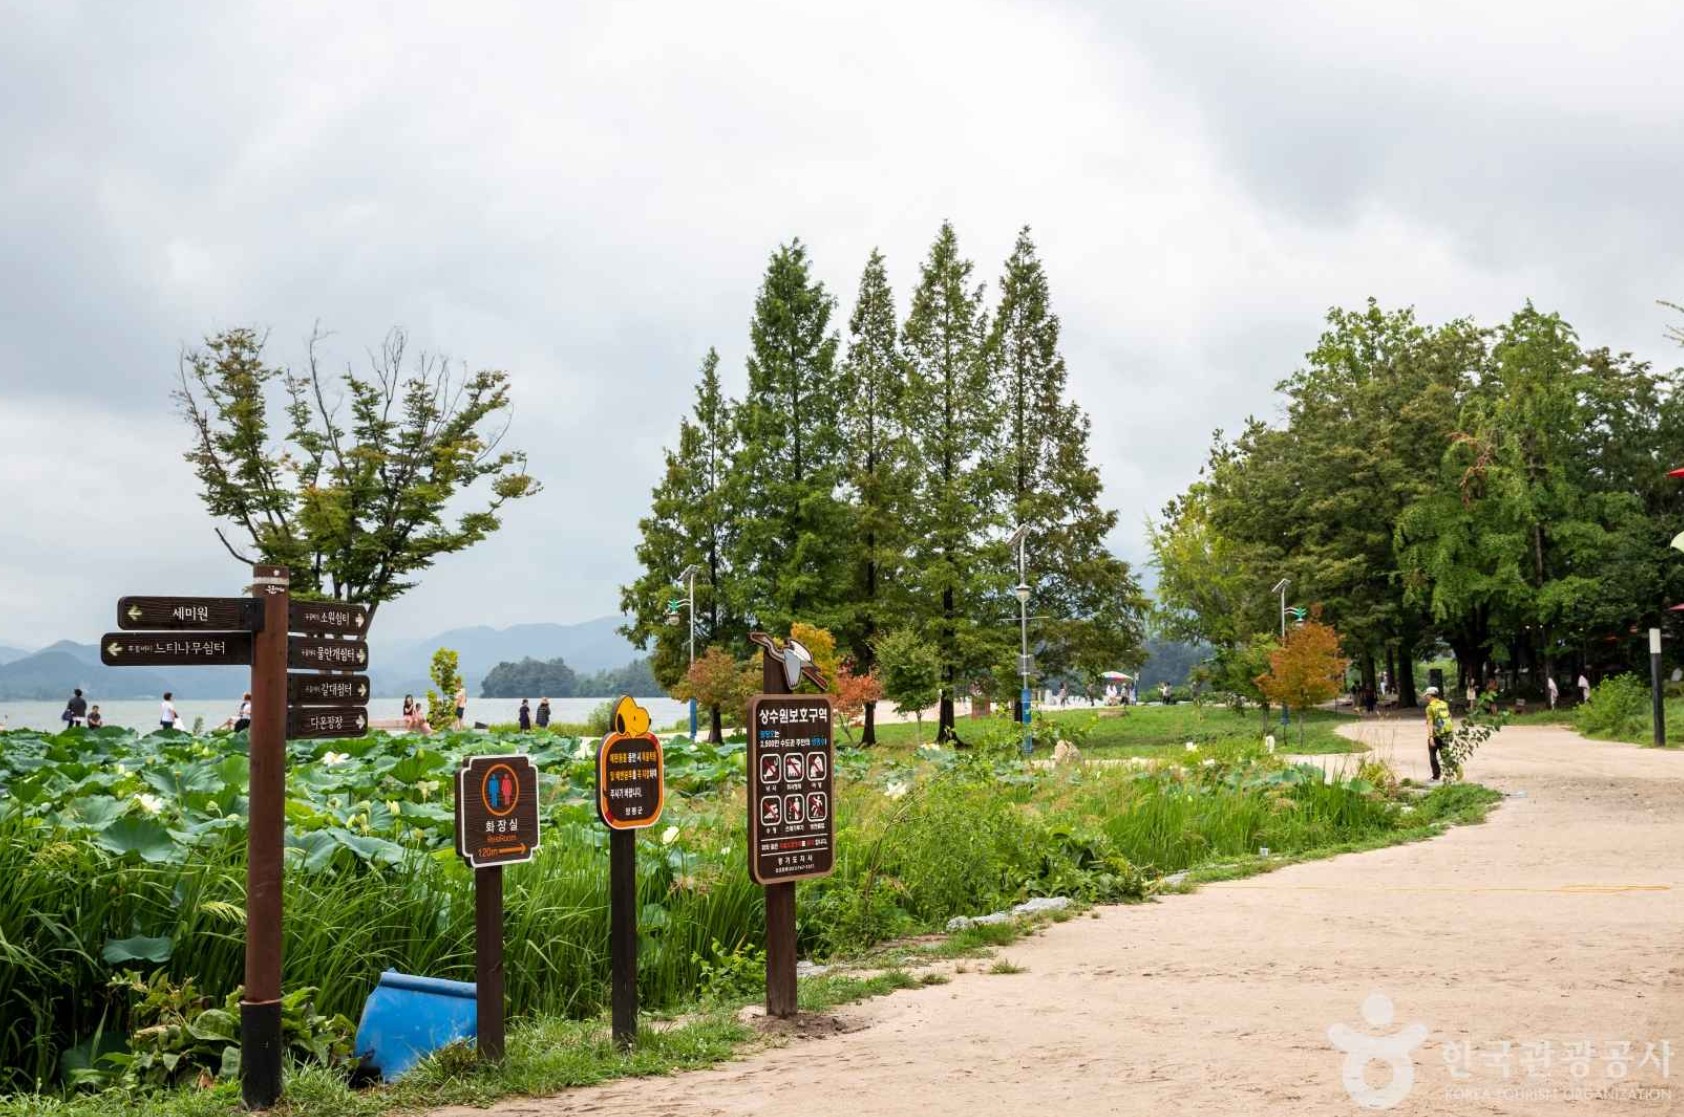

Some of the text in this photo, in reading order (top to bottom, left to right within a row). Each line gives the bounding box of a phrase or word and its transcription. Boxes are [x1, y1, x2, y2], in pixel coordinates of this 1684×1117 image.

[172, 606, 209, 622] 세미원
[320, 610, 350, 626] 소원쉼터
[154, 641, 226, 656] 느티나무쉼터
[317, 646, 355, 662] 물안개쉼터
[320, 682, 352, 697] 갈대쉼터
[759, 708, 828, 725] 상수원보호구역
[486, 818, 518, 833] 화장실
